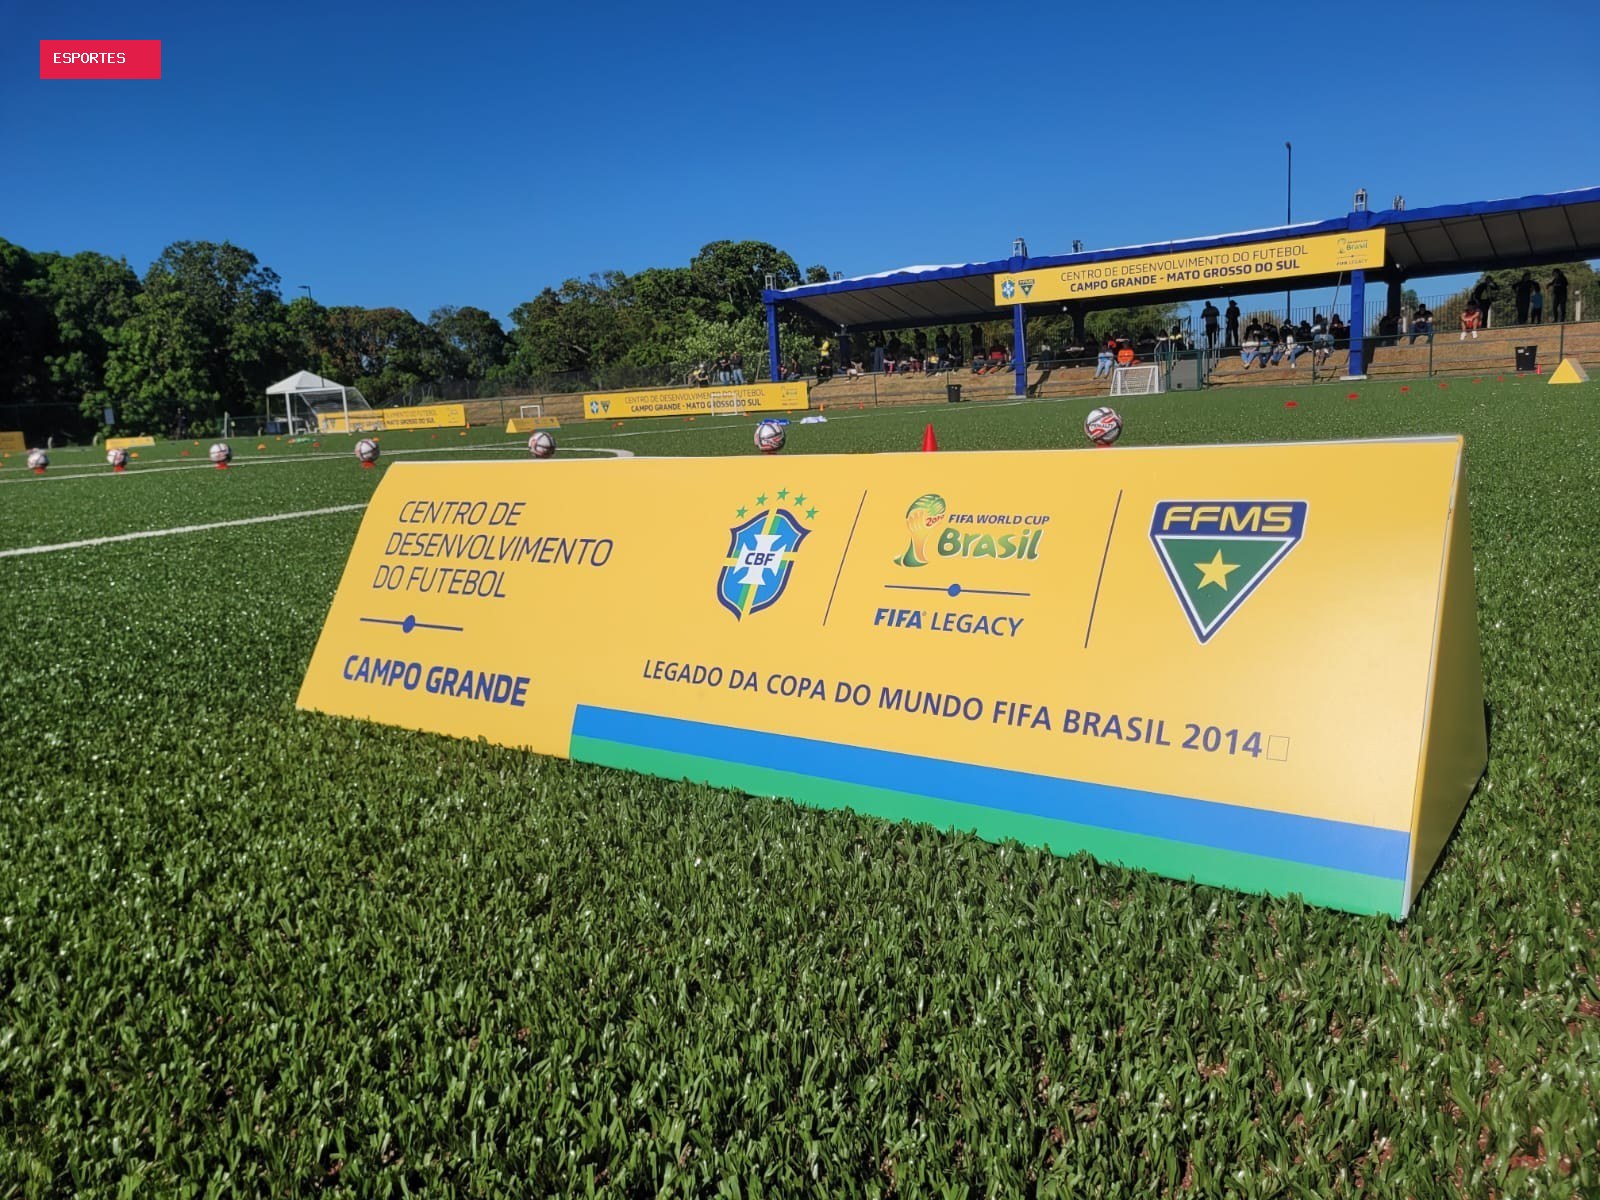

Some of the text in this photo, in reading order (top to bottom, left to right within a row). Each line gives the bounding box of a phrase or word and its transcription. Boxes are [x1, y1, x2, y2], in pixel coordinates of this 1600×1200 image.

[1060, 244, 1309, 282] CENTRO DE DESENVOLVIMENTO DO FUTEBOL
[1070, 279, 1108, 293] CAMPO
[1110, 272, 1157, 288] GRANDE
[1167, 270, 1200, 283] MATO
[1203, 262, 1252, 278] GROSSO
[1255, 262, 1273, 273] DO
[1276, 258, 1301, 271] SUL
[624, 395, 648, 404] CENTRO
[650, 394, 658, 402] DE
[631, 404, 653, 412] CAMPO
[654, 403, 681, 411] GRANDE
[686, 401, 705, 409] MATO
[747, 398, 761, 406] SUL
[399, 501, 526, 526] CENTRO DE
[948, 514, 1050, 526] FIFA WORLD CUP
[1162, 506, 1293, 532] FFMS
[385, 532, 614, 567] DESENVOLVIMENTO
[937, 527, 1043, 560] Brasil
[744, 552, 776, 566] CBF
[372, 564, 506, 598] DO FUTEBOL
[930, 611, 1025, 638] LEGACY
[343, 654, 531, 707] CAMPO GRANDE
[643, 659, 1263, 758] LEGADO DA COPA DO MUNDO FIFA BRASIL 2014
